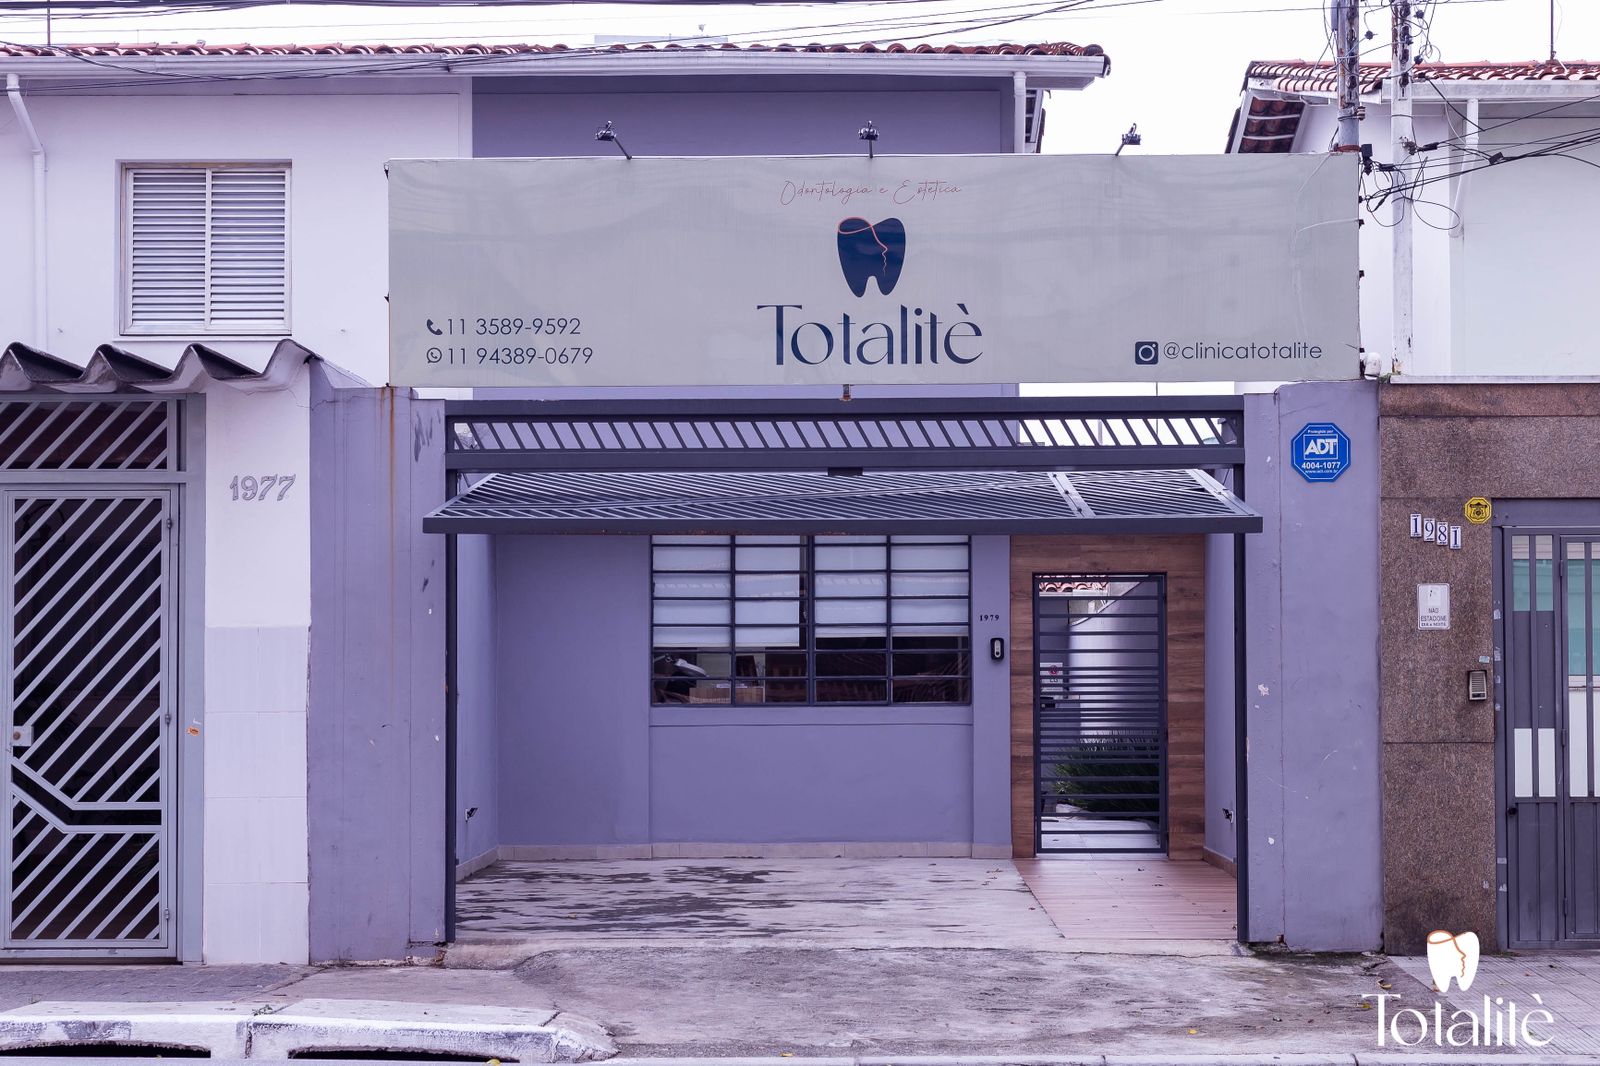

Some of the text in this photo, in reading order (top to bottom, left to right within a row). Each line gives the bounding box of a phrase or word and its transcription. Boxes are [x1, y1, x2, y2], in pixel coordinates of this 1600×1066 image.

[780, 180, 873, 206] Odontologia
[447, 317, 582, 336] 11 3589-9592
[756, 303, 984, 366] Totalitè
[448, 346, 594, 366] 11 94389-0679
[1163, 341, 1323, 360] @clinicatotalite
[1304, 438, 1338, 455] ADT
[1301, 461, 1341, 470] 4004-1077
[229, 473, 297, 502] 1977
[1411, 516, 1460, 547] 1981
[979, 614, 1000, 622] 1979
